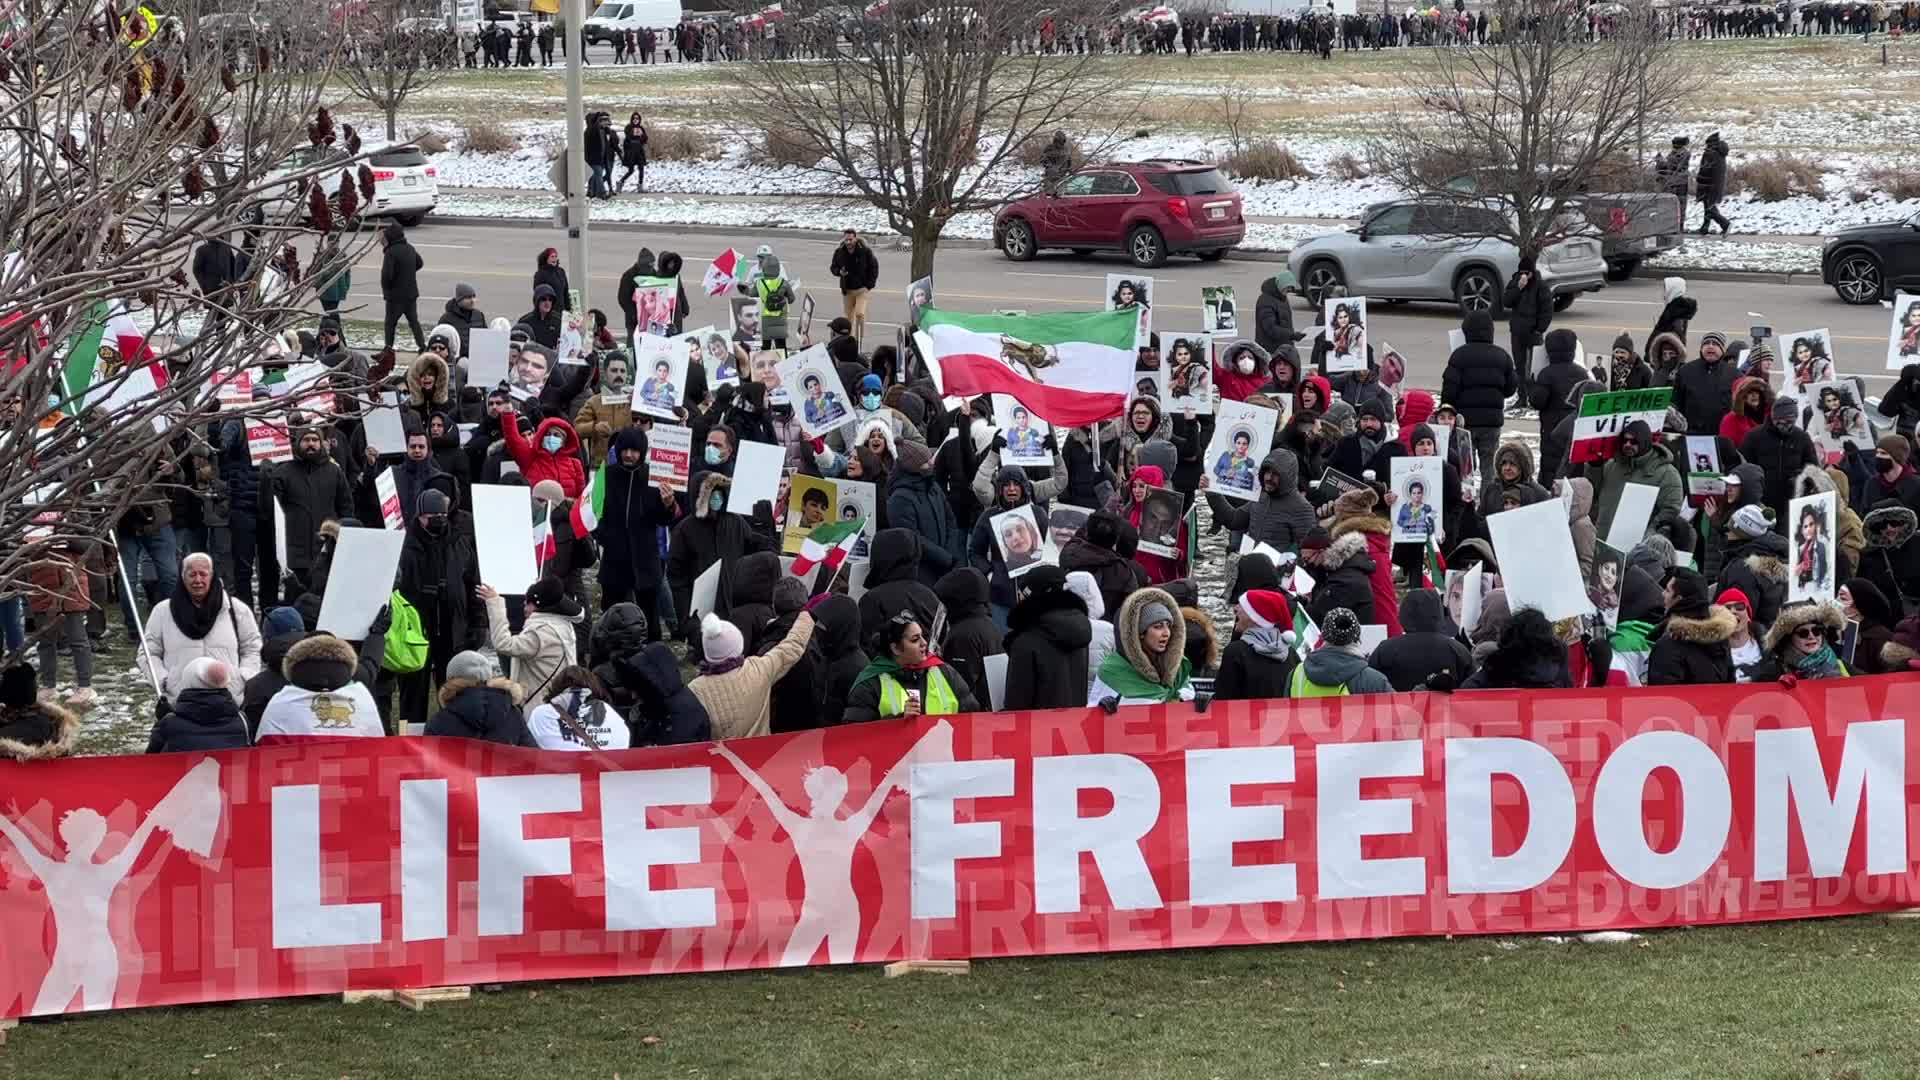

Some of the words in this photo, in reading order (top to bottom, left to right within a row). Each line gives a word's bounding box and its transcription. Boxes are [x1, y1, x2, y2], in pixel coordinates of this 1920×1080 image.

[1596, 392, 1665, 412] FEMME
[656, 450, 685, 463] People
[272, 769, 716, 948] LIFE
[912, 719, 1906, 919] FREEDOM
